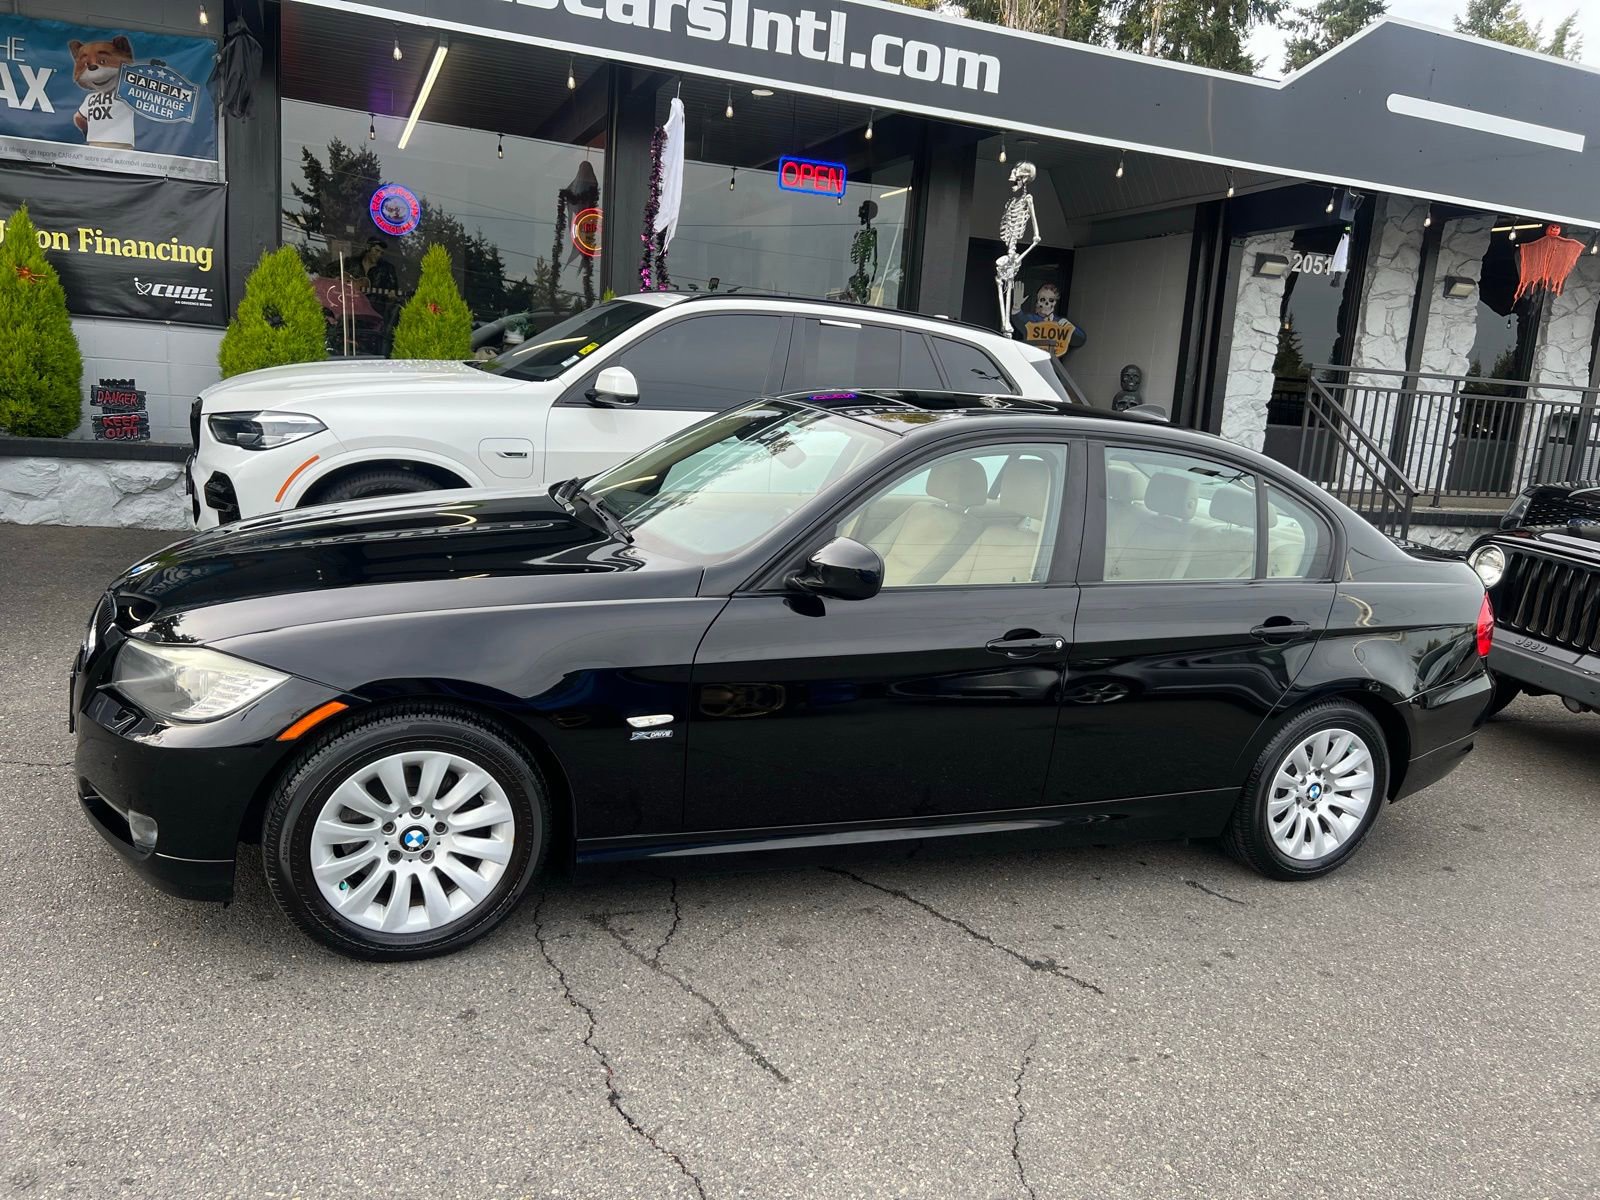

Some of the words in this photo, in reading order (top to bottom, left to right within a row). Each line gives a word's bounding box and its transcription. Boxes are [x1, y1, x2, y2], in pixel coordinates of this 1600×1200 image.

[127, 74, 190, 101] CARFAX
[87, 91, 113, 107] CAR
[128, 87, 185, 111] ADVANTAGE
[135, 99, 174, 119] DEALER
[87, 106, 114, 121] FOX
[781, 161, 843, 192] OPEN
[77, 227, 214, 272] Financing
[1291, 253, 1332, 276] 2051
[1032, 326, 1069, 341] SLOW
[97, 390, 138, 406] DANGER
[102, 415, 140, 427] KEEP
